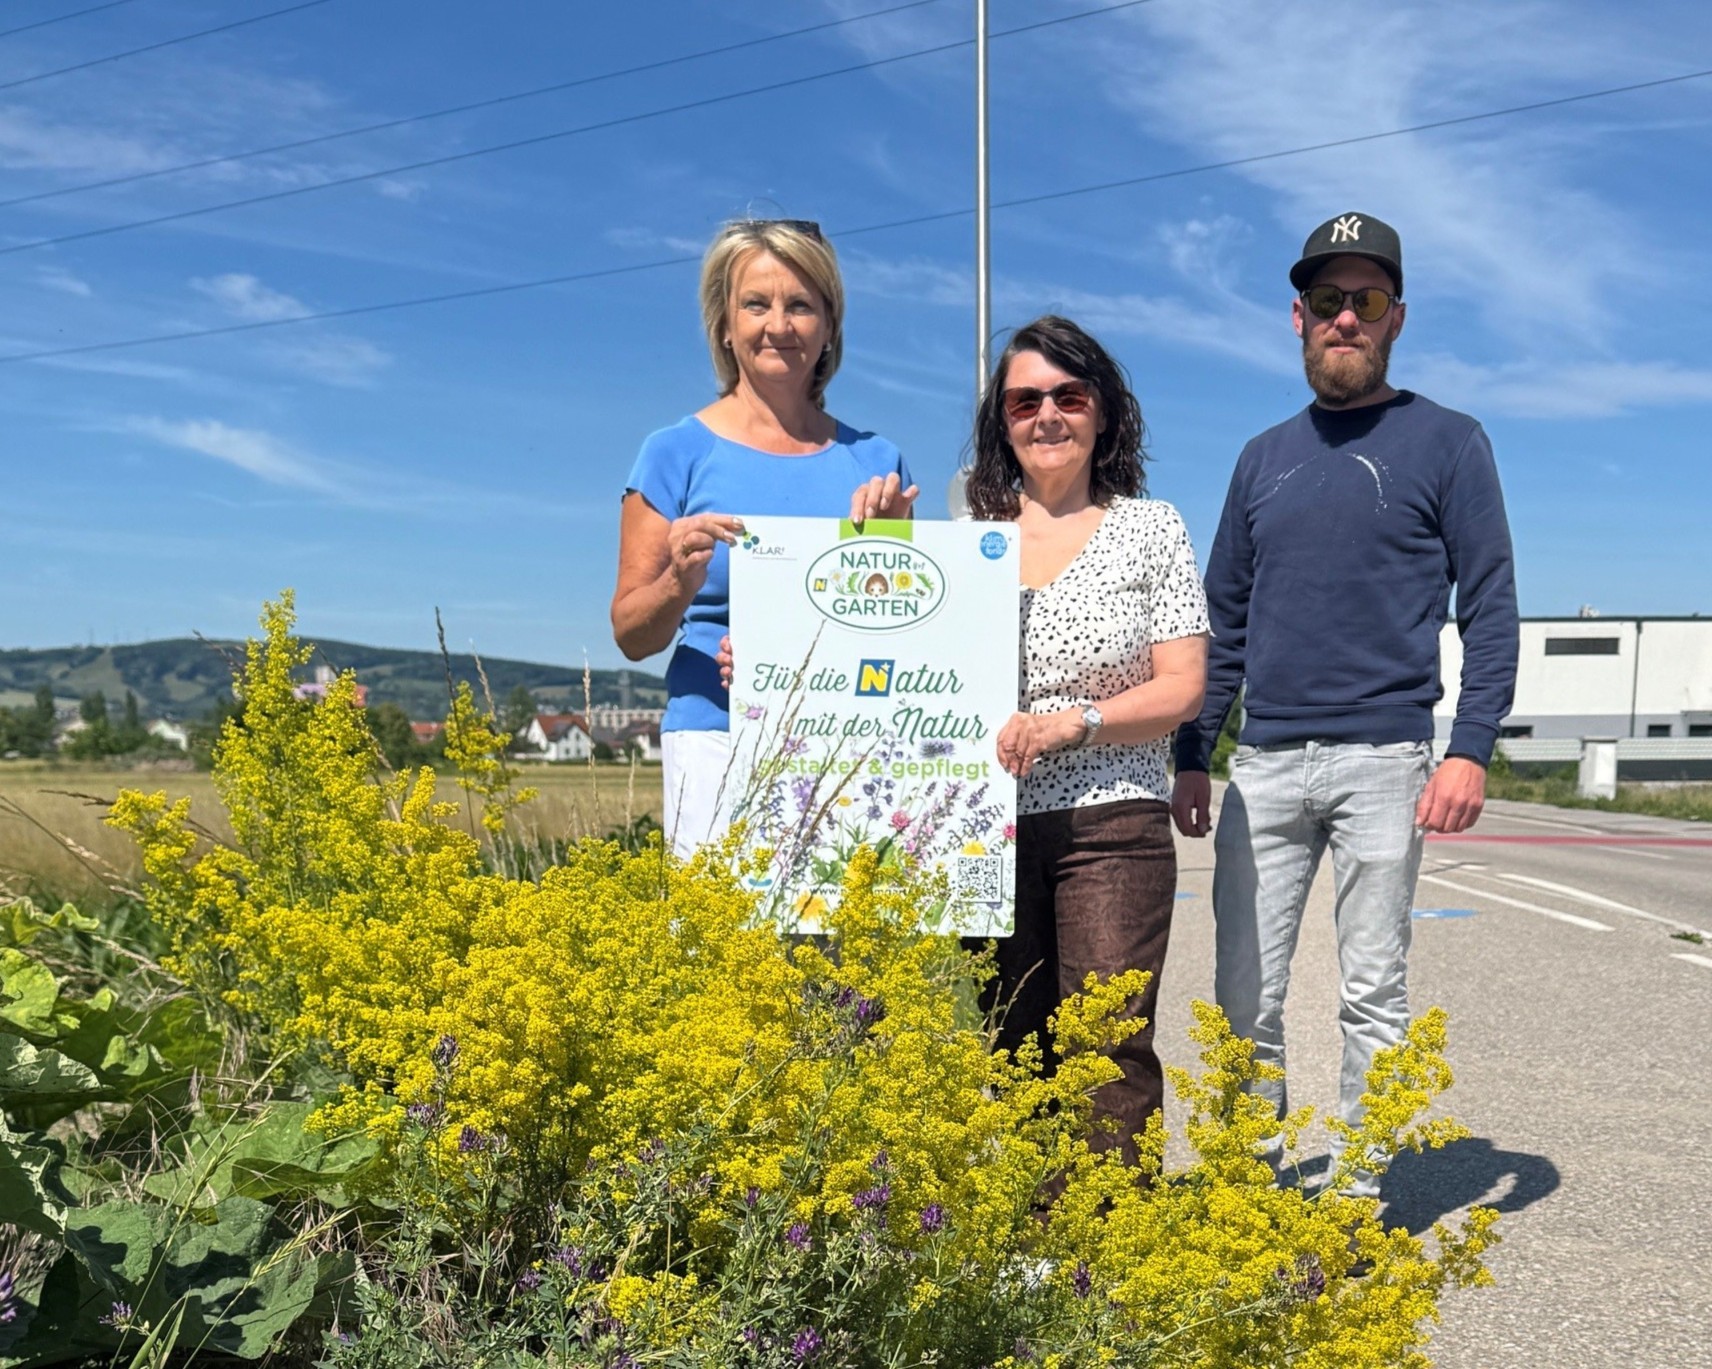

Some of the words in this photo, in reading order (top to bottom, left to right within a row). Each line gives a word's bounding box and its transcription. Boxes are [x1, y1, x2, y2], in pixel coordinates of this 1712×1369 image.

[1330, 215, 1363, 243] NY
[840, 551, 912, 570] NATUR
[832, 598, 919, 617] GARTEN
[809, 667, 850, 692] die
[793, 712, 837, 737] mit
[842, 713, 885, 738] der
[892, 707, 988, 746] Natur
[868, 757, 883, 776] &
[892, 757, 990, 781] gepflegt
